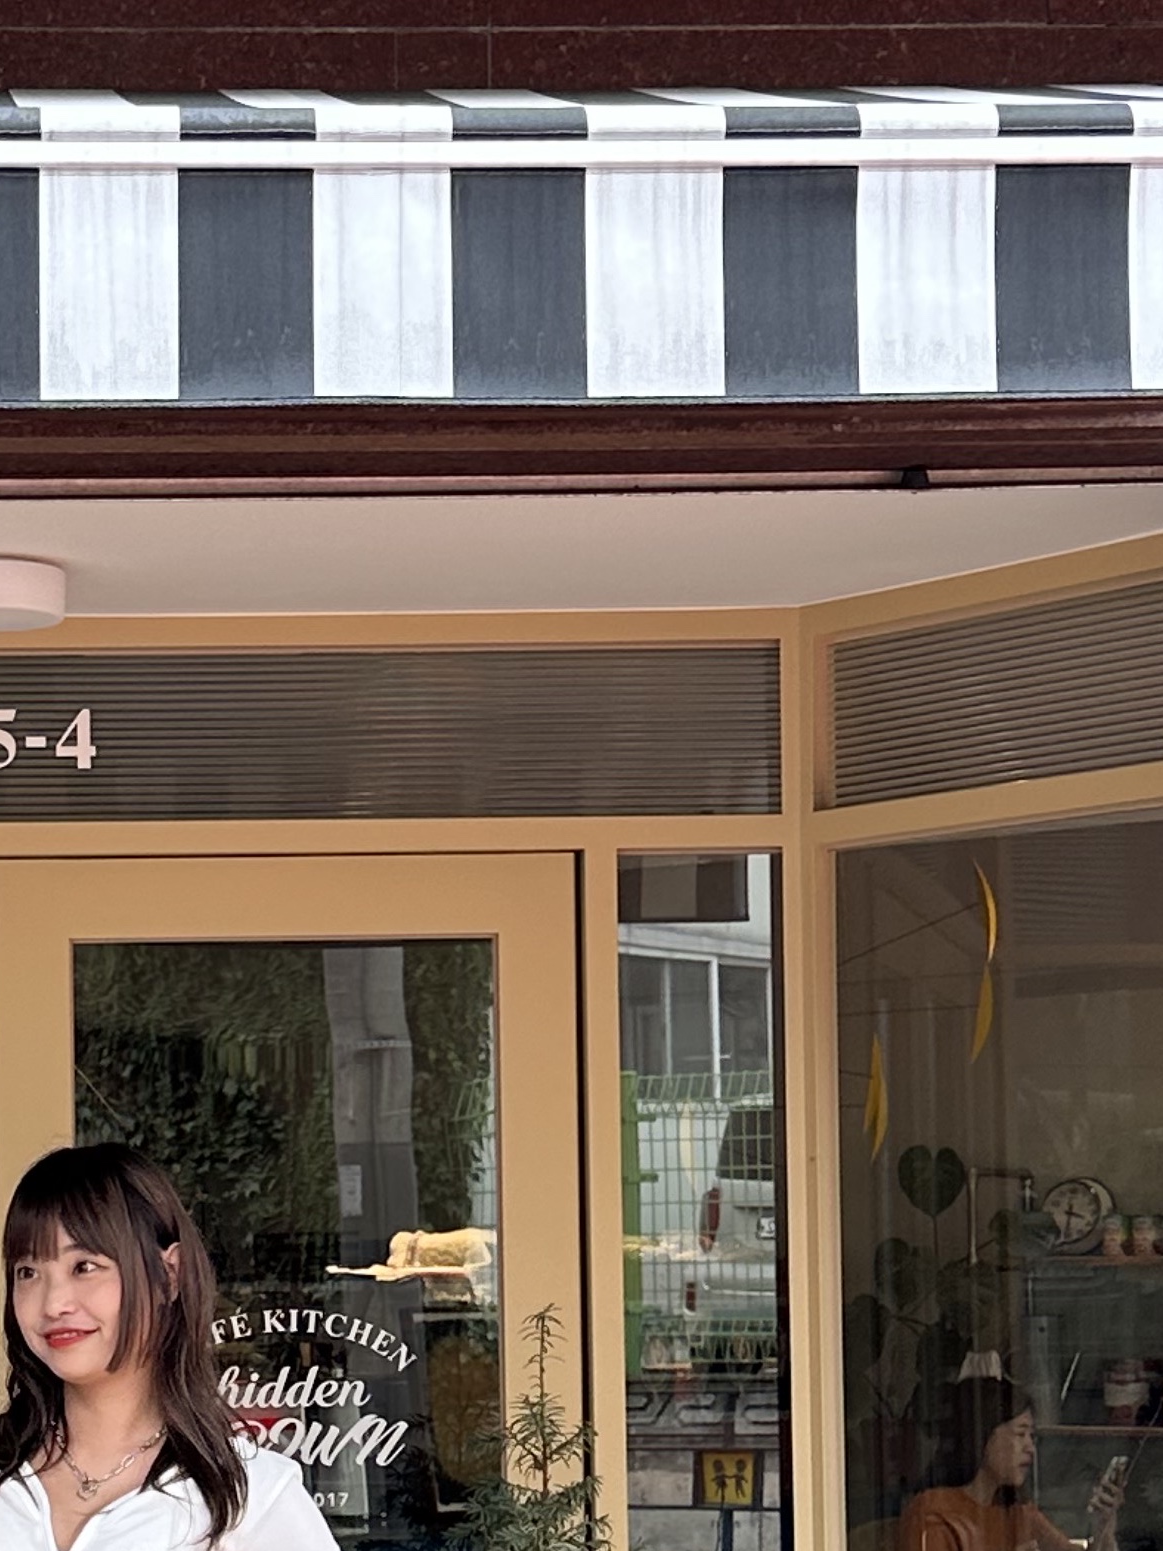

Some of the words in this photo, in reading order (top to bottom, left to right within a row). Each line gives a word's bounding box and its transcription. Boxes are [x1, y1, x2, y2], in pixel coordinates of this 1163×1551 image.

[211, 1306, 252, 1345] FÉ
[261, 1308, 418, 1372] KITCHEN
[217, 1364, 372, 1409] hidden
[313, 1491, 350, 1508] 017
